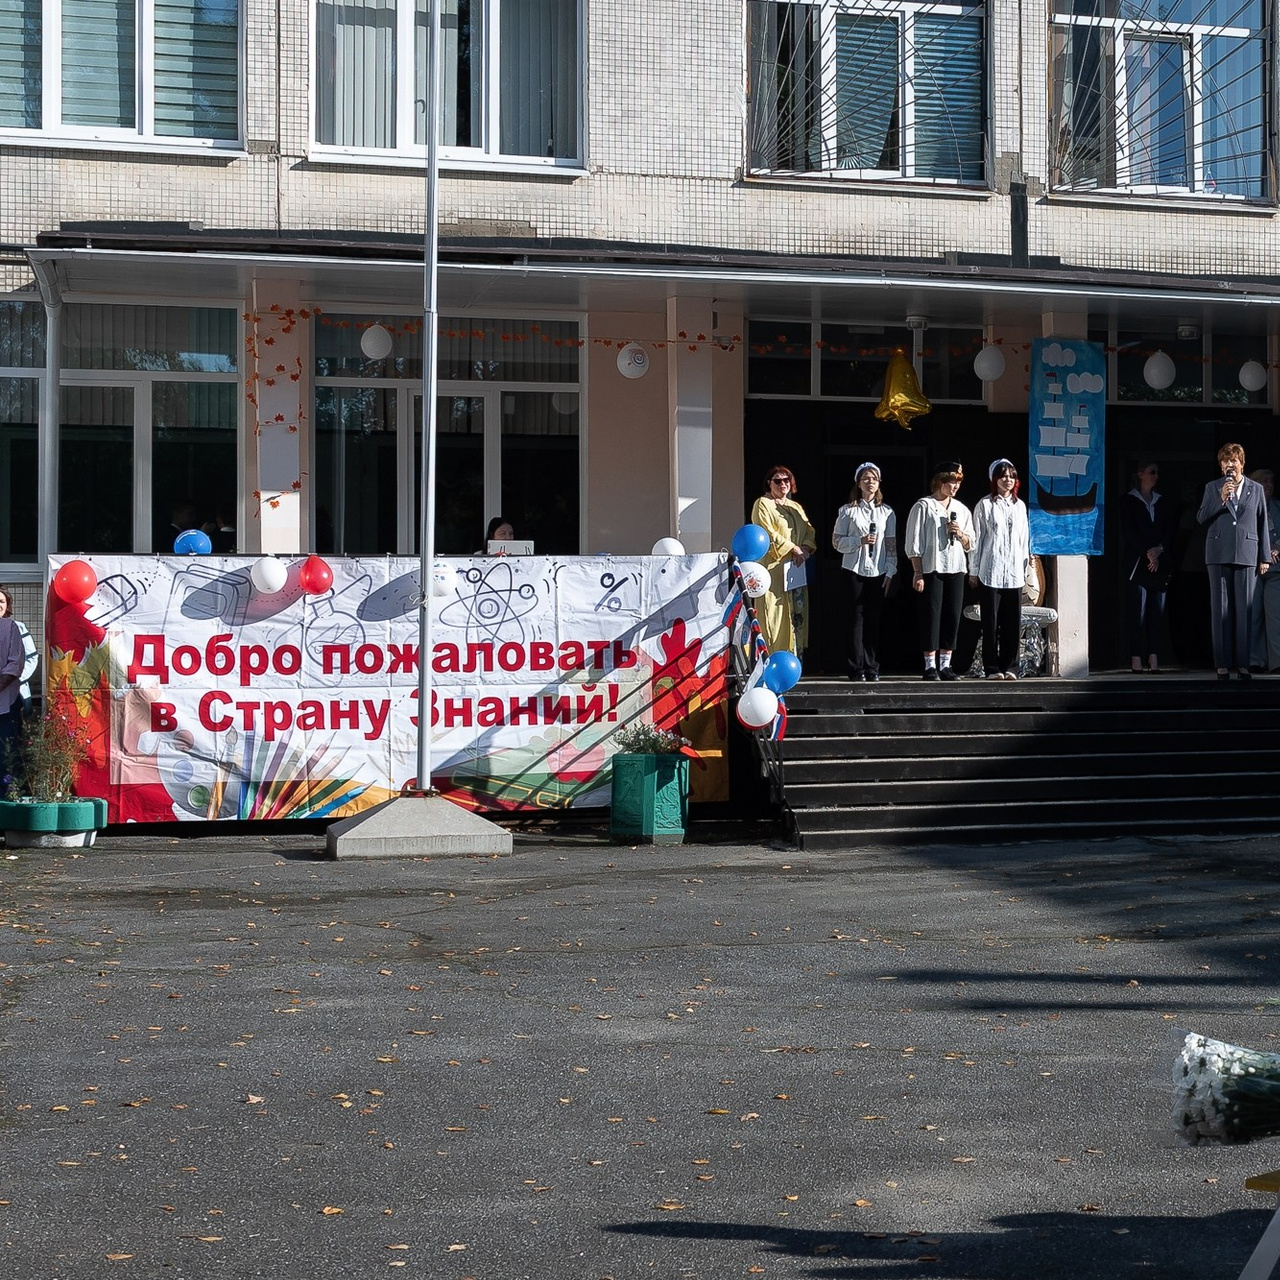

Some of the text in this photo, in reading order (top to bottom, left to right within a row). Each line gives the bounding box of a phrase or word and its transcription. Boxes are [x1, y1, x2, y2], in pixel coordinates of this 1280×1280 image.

[128, 634, 638, 686] Добро пожаловать
[150, 683, 619, 741] в Страну Знаний!
